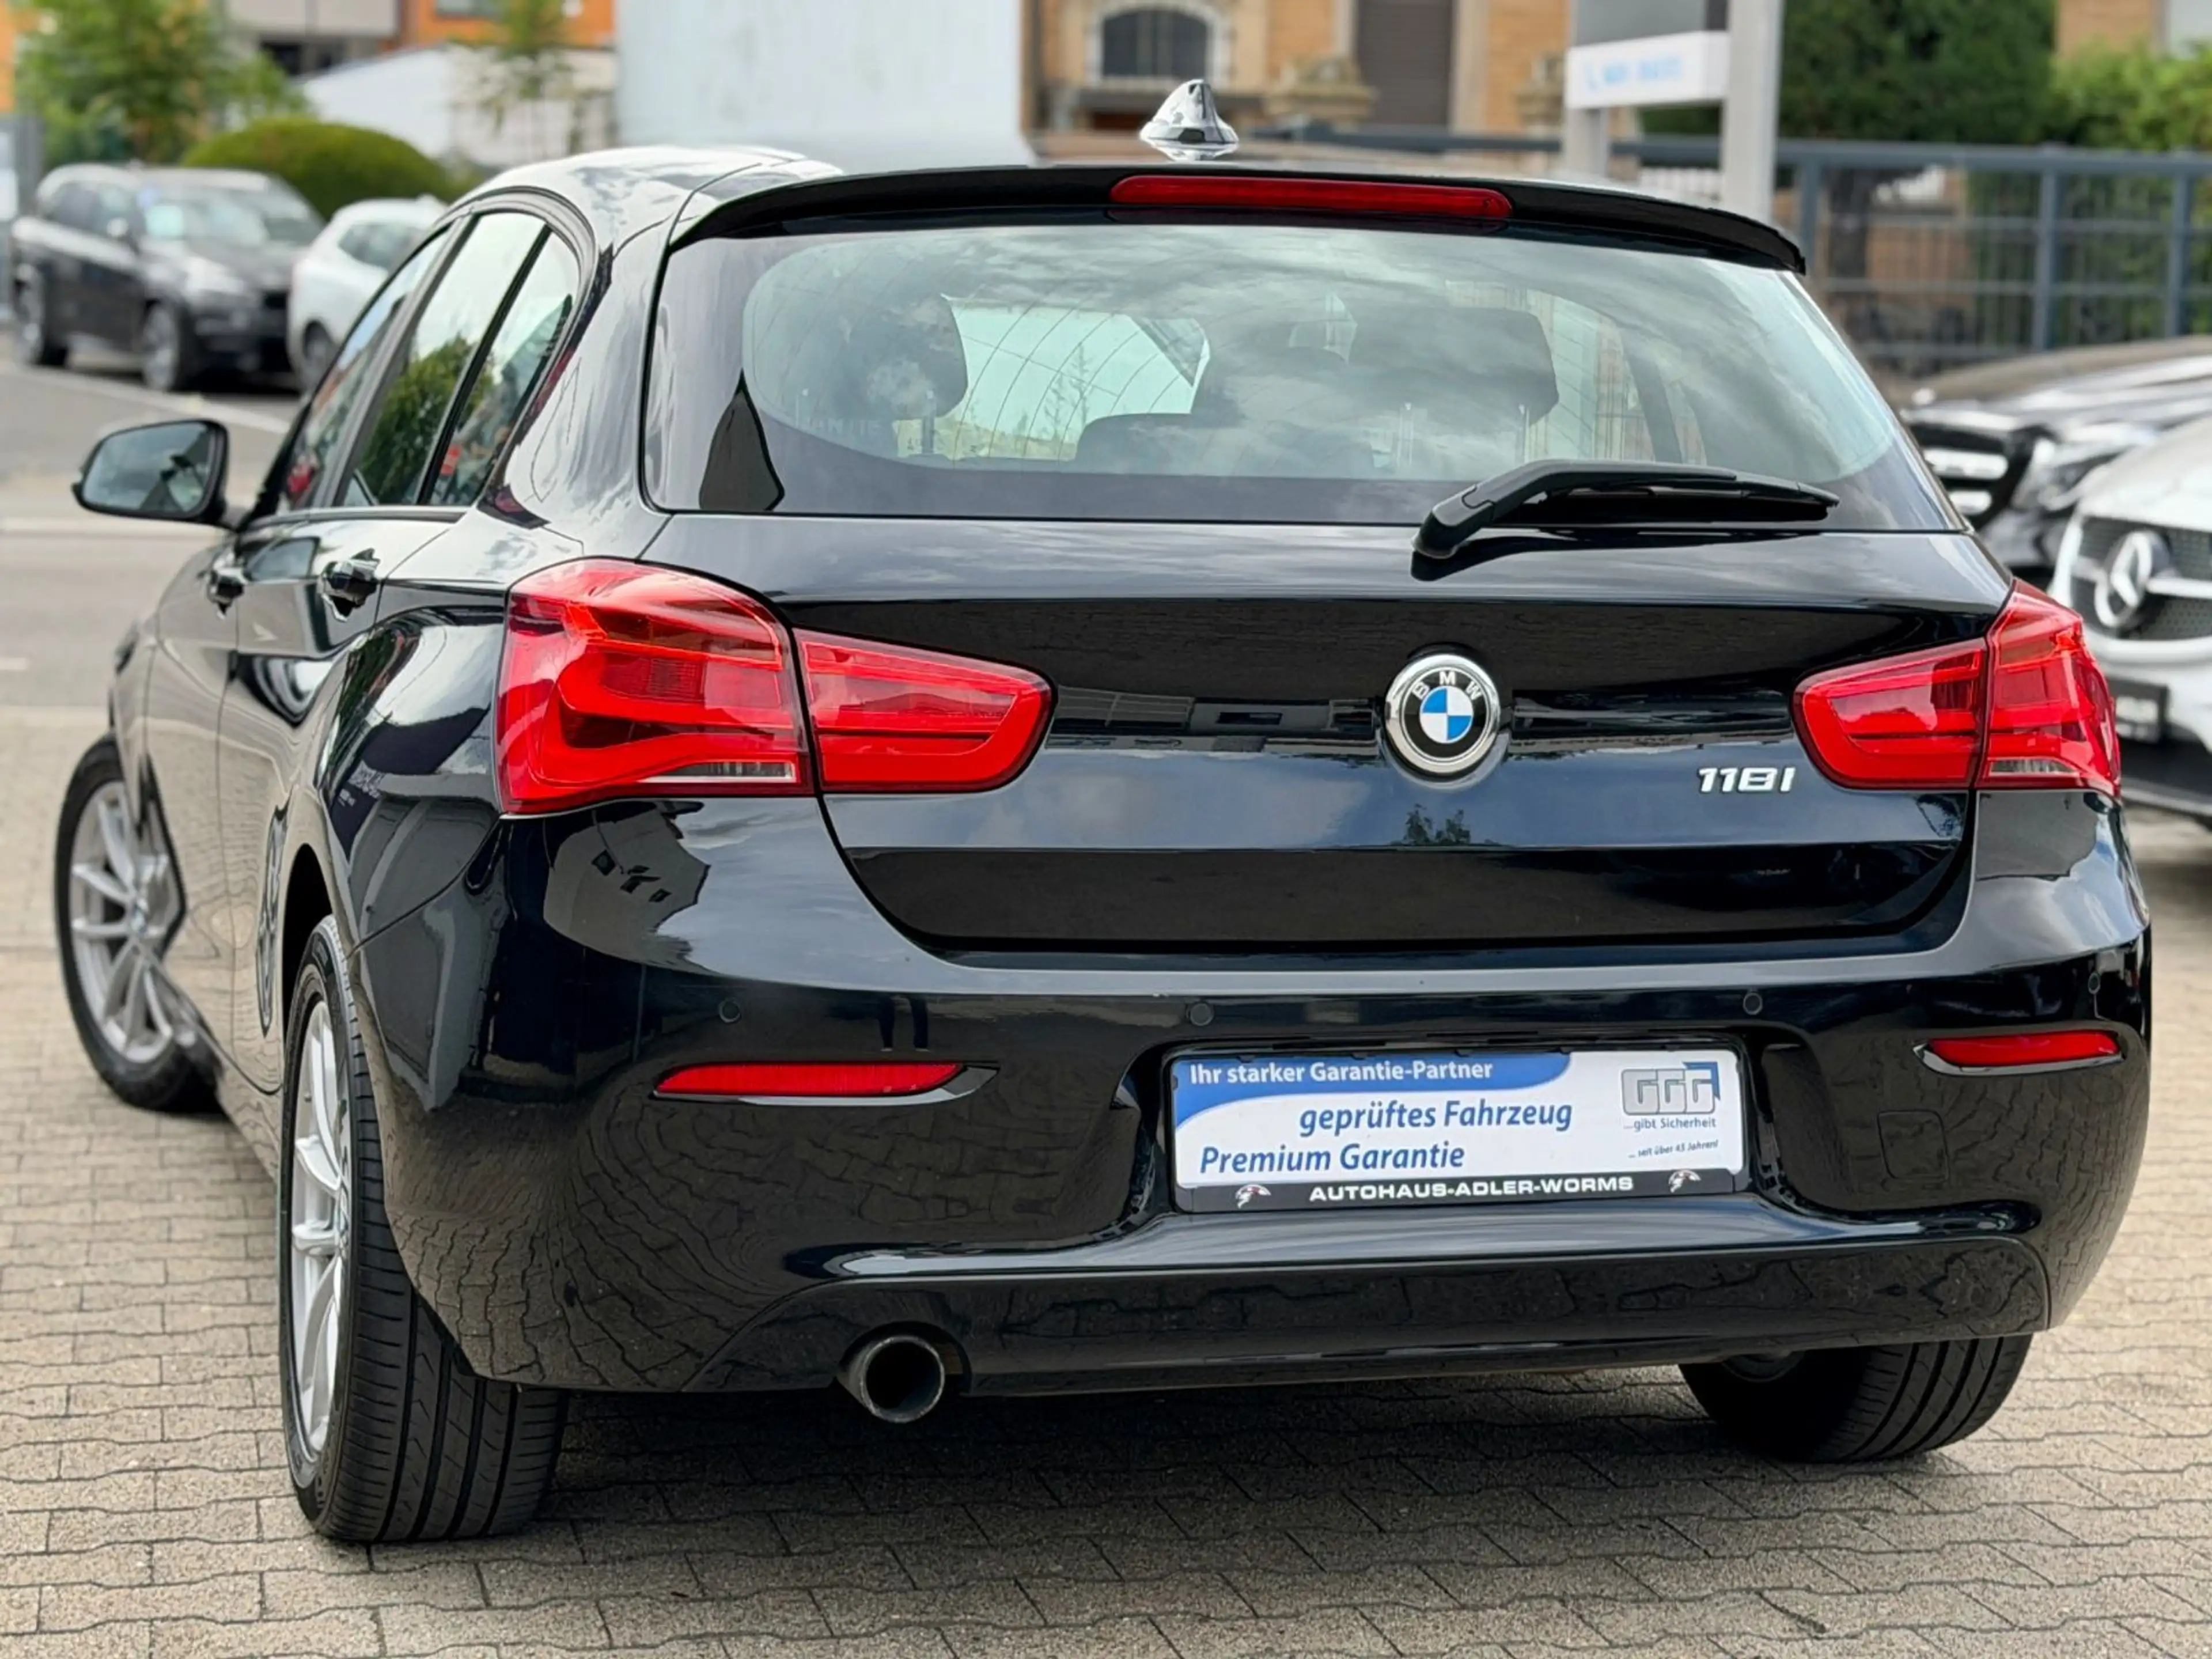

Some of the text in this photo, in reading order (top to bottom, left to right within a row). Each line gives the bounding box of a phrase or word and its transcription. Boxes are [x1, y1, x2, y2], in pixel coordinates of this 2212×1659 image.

[1411, 670, 1483, 701] BMW
[1190, 1060, 1493, 1084] Ihr starker Garantie-Partner
[1299, 1098, 1573, 1138] geprüftes Fahrzeug
[1660, 1116, 1717, 1129] Sicherheit
[1200, 1141, 1465, 1173] Premium Garantie
[1309, 1176, 1634, 1202] AUTOHAUS-ADLER-WORMS
